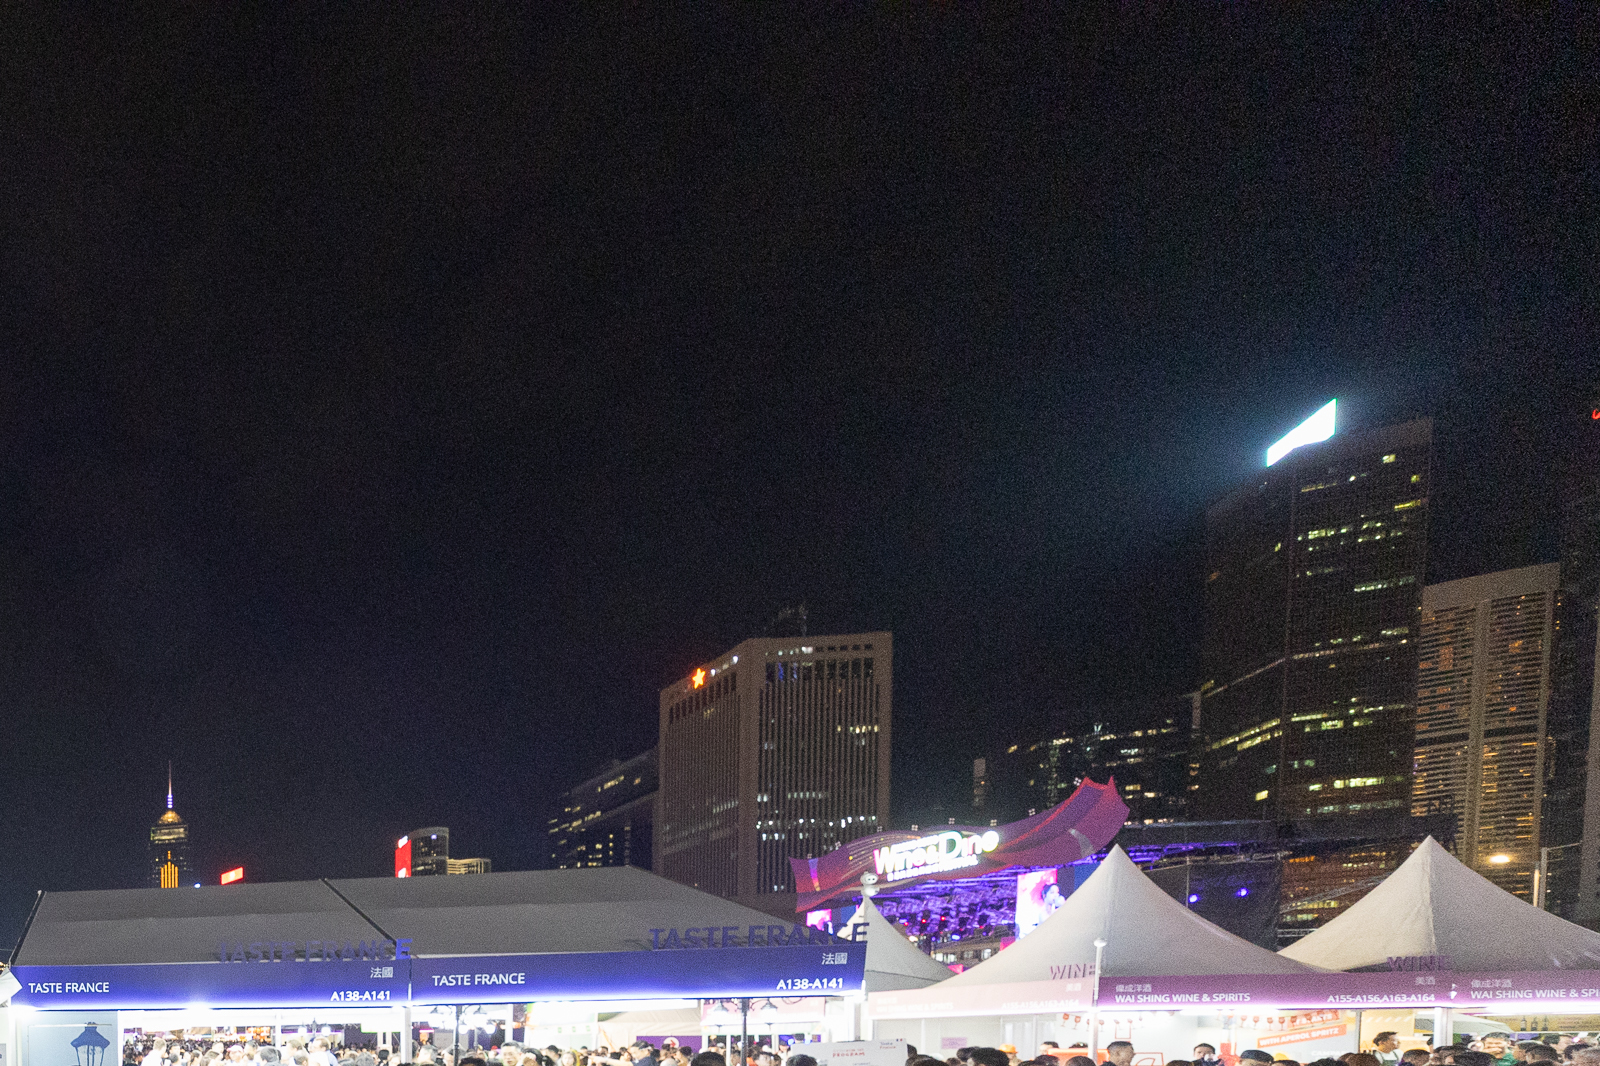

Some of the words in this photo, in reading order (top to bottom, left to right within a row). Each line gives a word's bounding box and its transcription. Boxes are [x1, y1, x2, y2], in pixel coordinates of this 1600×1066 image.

[650, 926, 739, 950] TASTE
[750, 922, 869, 947] FRANCE
[215, 940, 295, 963] TASTE
[305, 938, 413, 960] FRANCE
[822, 953, 847, 965] 法國
[370, 967, 394, 979] 法國
[1050, 963, 1096, 980] WINE
[432, 974, 471, 986] TASTE
[474, 973, 526, 985] FRANCE
[776, 978, 844, 990] A138-A141
[28, 983, 63, 994] TASTE
[65, 982, 110, 993] FRANCE
[1471, 990, 1494, 999] WAI
[1496, 990, 1532, 999] SHING
[1535, 990, 1566, 999] WINE
[1569, 989, 1579, 998] &
[330, 991, 390, 1001] A138-A141
[1115, 994, 1136, 1003] WAI
[1137, 994, 1170, 1003] SHING
[1172, 993, 1200, 1002] WINE
[1202, 993, 1211, 1002] &
[1212, 992, 1251, 1002] SPIRITS
[1327, 993, 1435, 1003] A155-A156,A163-A164
[1259, 1037, 1280, 1046] WITH
[1281, 1033, 1310, 1043] APEROL
[1311, 1027, 1339, 1039] SPRITZ
